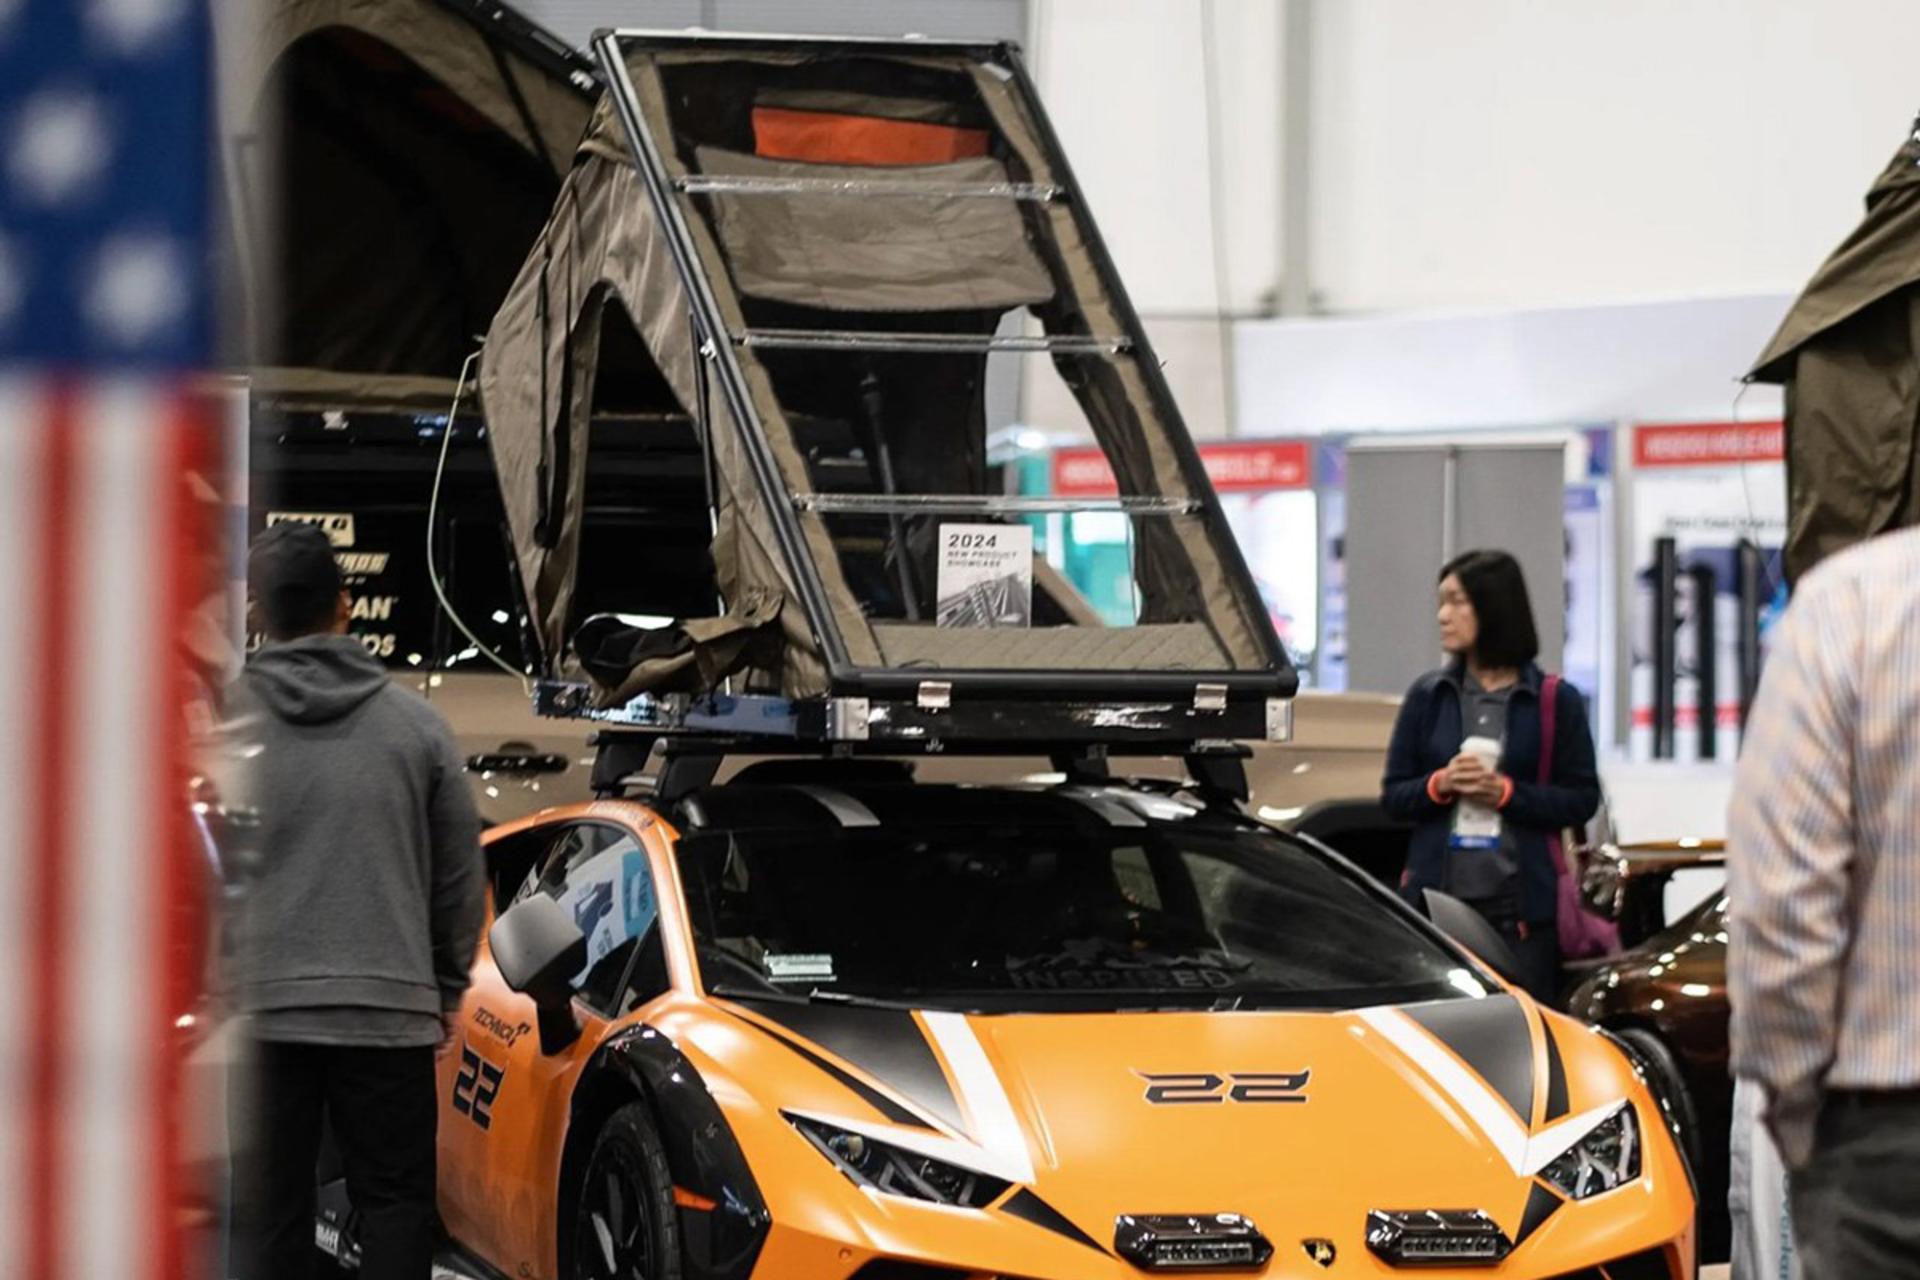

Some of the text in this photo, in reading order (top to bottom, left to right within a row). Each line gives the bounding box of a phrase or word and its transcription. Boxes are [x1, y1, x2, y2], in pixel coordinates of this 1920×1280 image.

[948, 533, 997, 548] 2024
[453, 1044, 505, 1130] 22
[1131, 1069, 1311, 1104] 22
